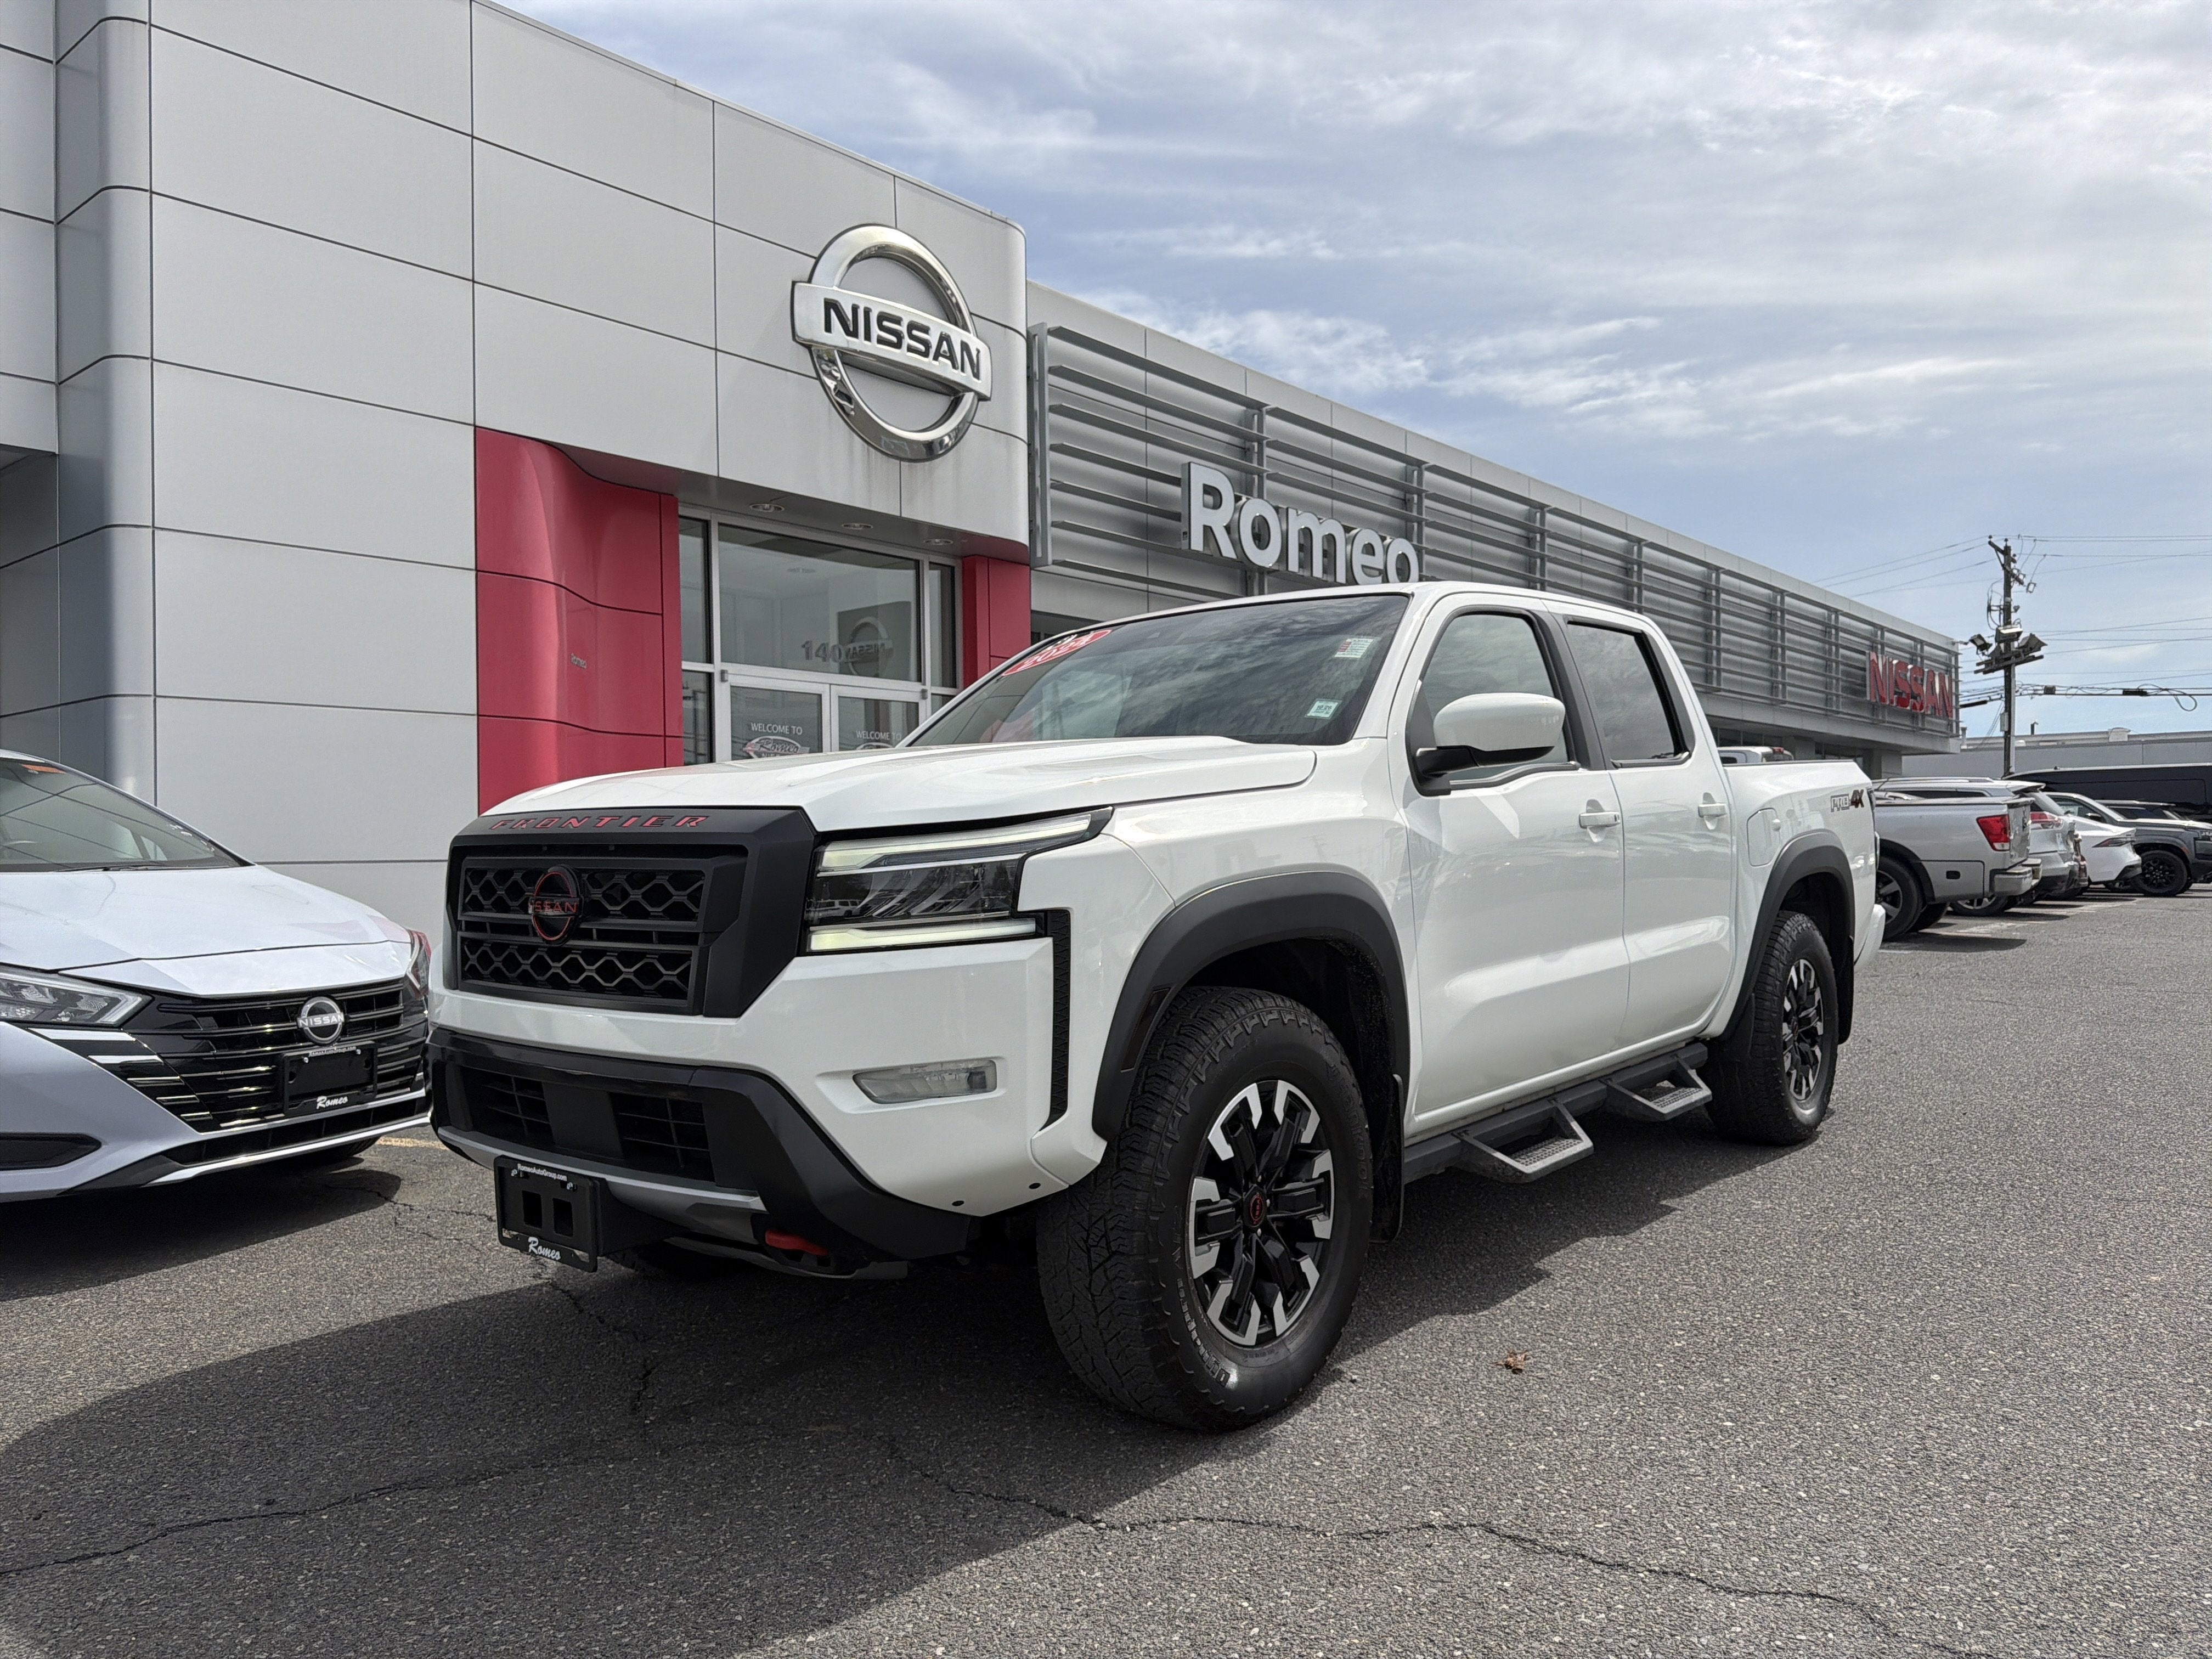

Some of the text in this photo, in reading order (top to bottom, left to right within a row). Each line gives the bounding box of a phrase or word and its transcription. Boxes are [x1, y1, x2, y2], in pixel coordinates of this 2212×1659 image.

[823, 297, 980, 383] NISSAN
[1182, 462, 1419, 585] Romeo
[1869, 651, 1954, 719] NISSAN
[751, 722, 803, 735] WELCOME TO
[856, 730, 902, 741] WELCOME TO
[756, 737, 799, 754] Romeo
[489, 815, 712, 831] FRONTIER
[298, 1013, 345, 1028] NISSAN
[317, 1096, 348, 1110] Romeo
[517, 1163, 568, 1182] RomeoAutoGroup.com
[528, 1237, 561, 1261] Romeo
